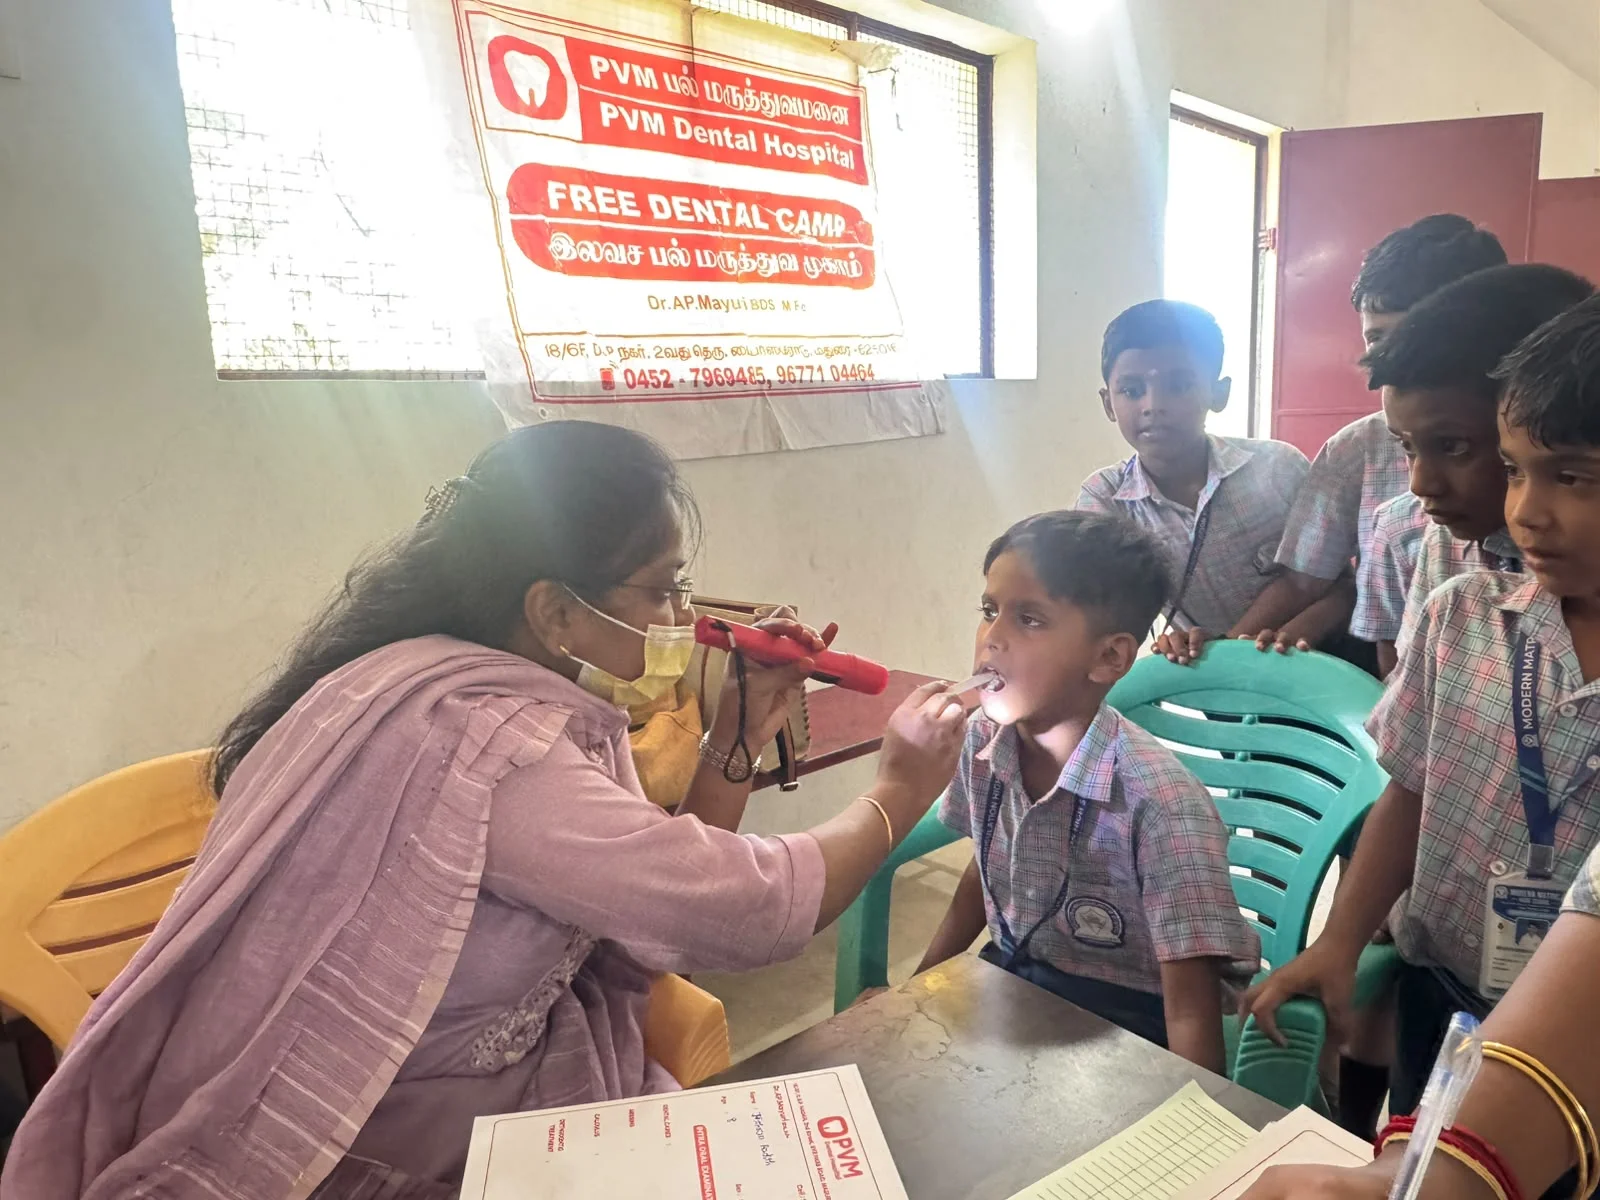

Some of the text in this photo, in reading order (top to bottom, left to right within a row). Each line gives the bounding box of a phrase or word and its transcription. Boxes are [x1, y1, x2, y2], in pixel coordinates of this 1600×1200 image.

[590, 55, 849, 126] PVM பல் மருத்துவமனை
[600, 101, 855, 170] PVM Dental Hospital
[547, 180, 846, 238] FREE DENTAL CAMP
[549, 231, 863, 279] இலவச பல் மருத்துவ முகாம்
[624, 368, 674, 389] 0452
[689, 366, 772, 389] 7969485,
[776, 364, 825, 385] 96771
[829, 363, 876, 383] 04464
[1521, 672, 1534, 729] MODERN
[832, 1137, 864, 1178] PVM
